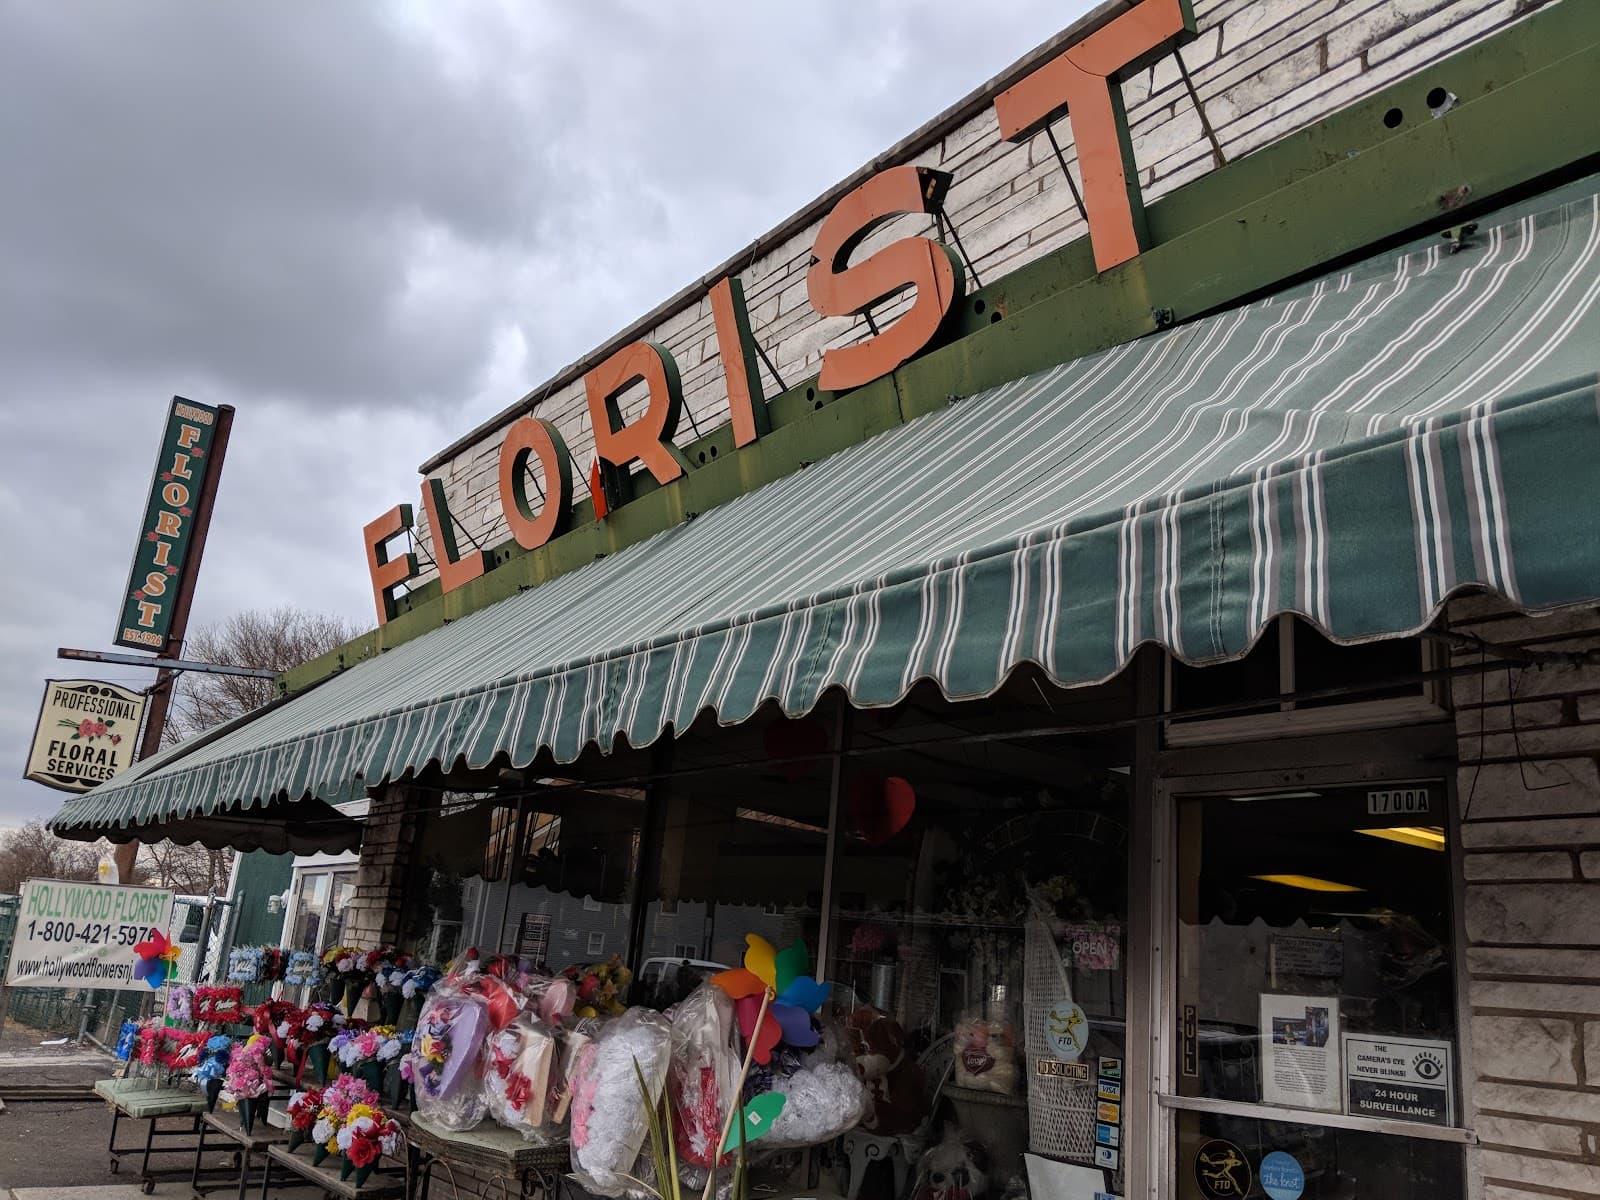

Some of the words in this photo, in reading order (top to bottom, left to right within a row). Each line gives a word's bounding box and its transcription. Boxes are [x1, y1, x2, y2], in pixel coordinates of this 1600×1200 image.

[364, 0, 1190, 625] FLORIST
[175, 403, 214, 425] HOLLYWOOD
[137, 424, 201, 627] FLORIST
[52, 690, 136, 720] PROFESSIONAL
[47, 740, 118, 767] FLORAL
[47, 758, 115, 780] SERVICES
[1371, 791, 1427, 812] 1700A
[26, 884, 112, 920] HOLLYWOOD
[112, 891, 169, 923] FLORIST
[1072, 941, 1108, 955] OPEN
[1058, 1036, 1072, 1046] FTD
[1186, 1007, 1194, 1072] PULL
[1357, 1054, 1391, 1064] CAMERA'S
[1392, 1058, 1405, 1066] EYE
[1039, 1061, 1049, 1074] NO
[1051, 1063, 1087, 1079] SOLICITING
[1356, 1065, 1378, 1074] NEVER
[1379, 1068, 1407, 1077] BLINKS!
[1102, 1085, 1117, 1095] VISA
[1374, 1089, 1387, 1098] 24
[1389, 1091, 1419, 1102] HOUR
[1359, 1099, 1437, 1117] SURVEILLANCE
[1213, 1180, 1231, 1190] FTD
[1263, 1172, 1279, 1185] the
